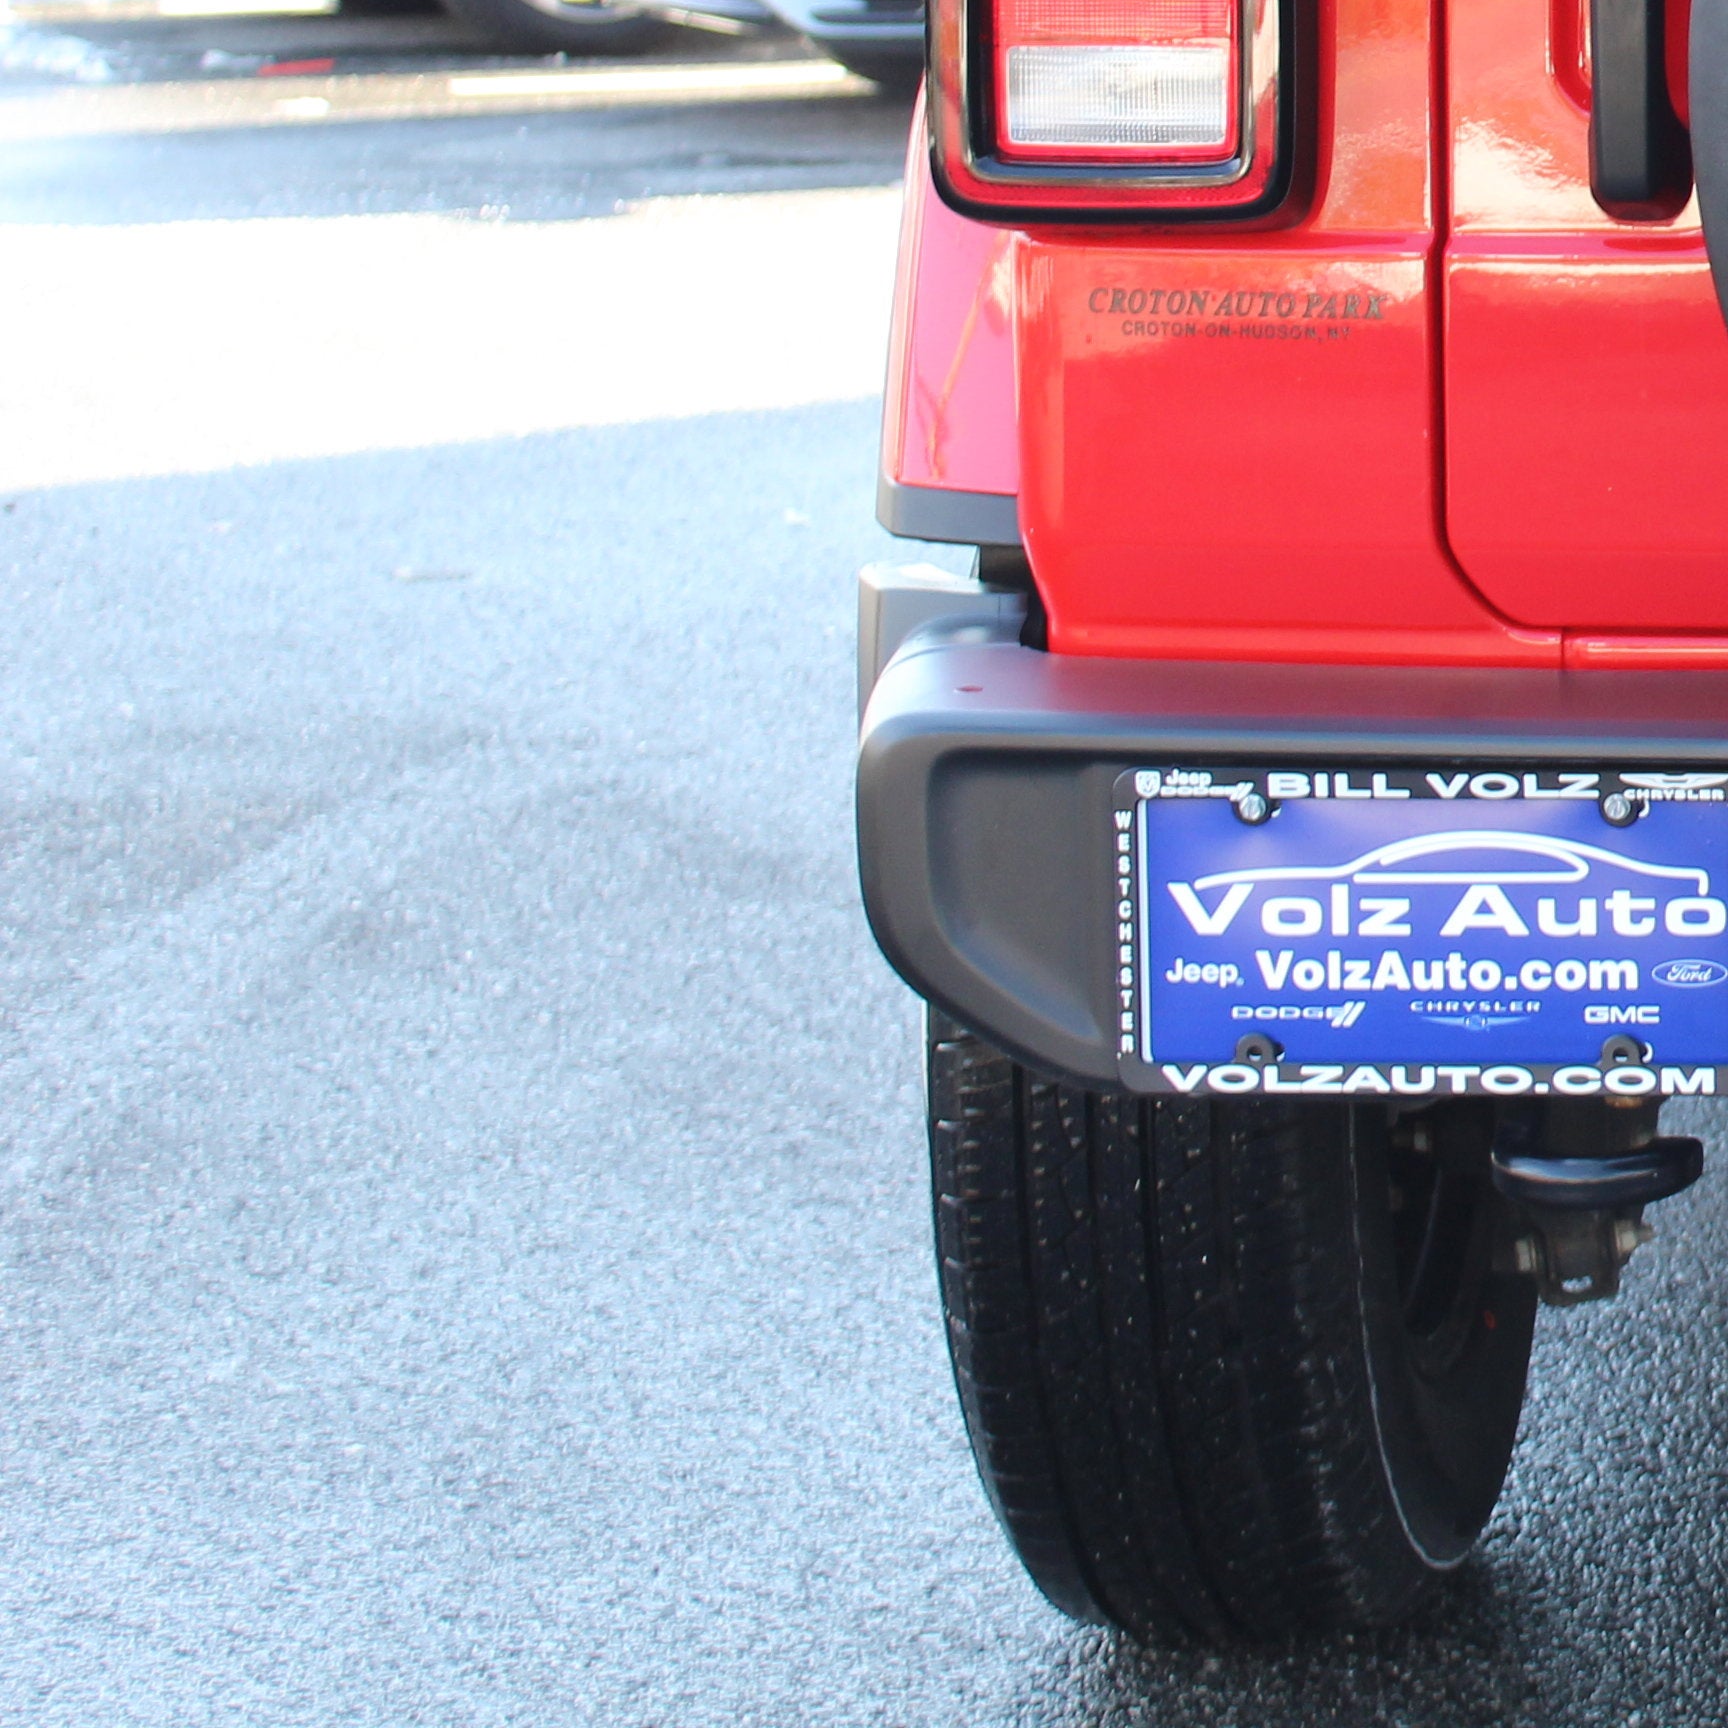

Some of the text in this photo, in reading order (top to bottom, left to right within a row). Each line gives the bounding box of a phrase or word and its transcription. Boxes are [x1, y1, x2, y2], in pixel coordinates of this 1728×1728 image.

[1089, 288, 1388, 319] CROTON AUTO PARK
[1165, 768, 1213, 786] Jeep
[1267, 772, 1600, 799] BILL VOLZ
[1624, 789, 1725, 801] CHRYSLER
[1167, 882, 1726, 936] Volz Auto
[1115, 811, 1135, 1054] WESTCHESTER
[1166, 957, 1239, 988] Jeep
[1255, 950, 1639, 991] VolzAuto.com
[1667, 962, 1711, 982] Ford
[1232, 1005, 1344, 1020] DODGE
[1409, 1000, 1541, 1012] CHRYSLER
[1584, 1005, 1660, 1023] GMC
[1162, 1065, 1716, 1094] VOLZAUTO.COM
